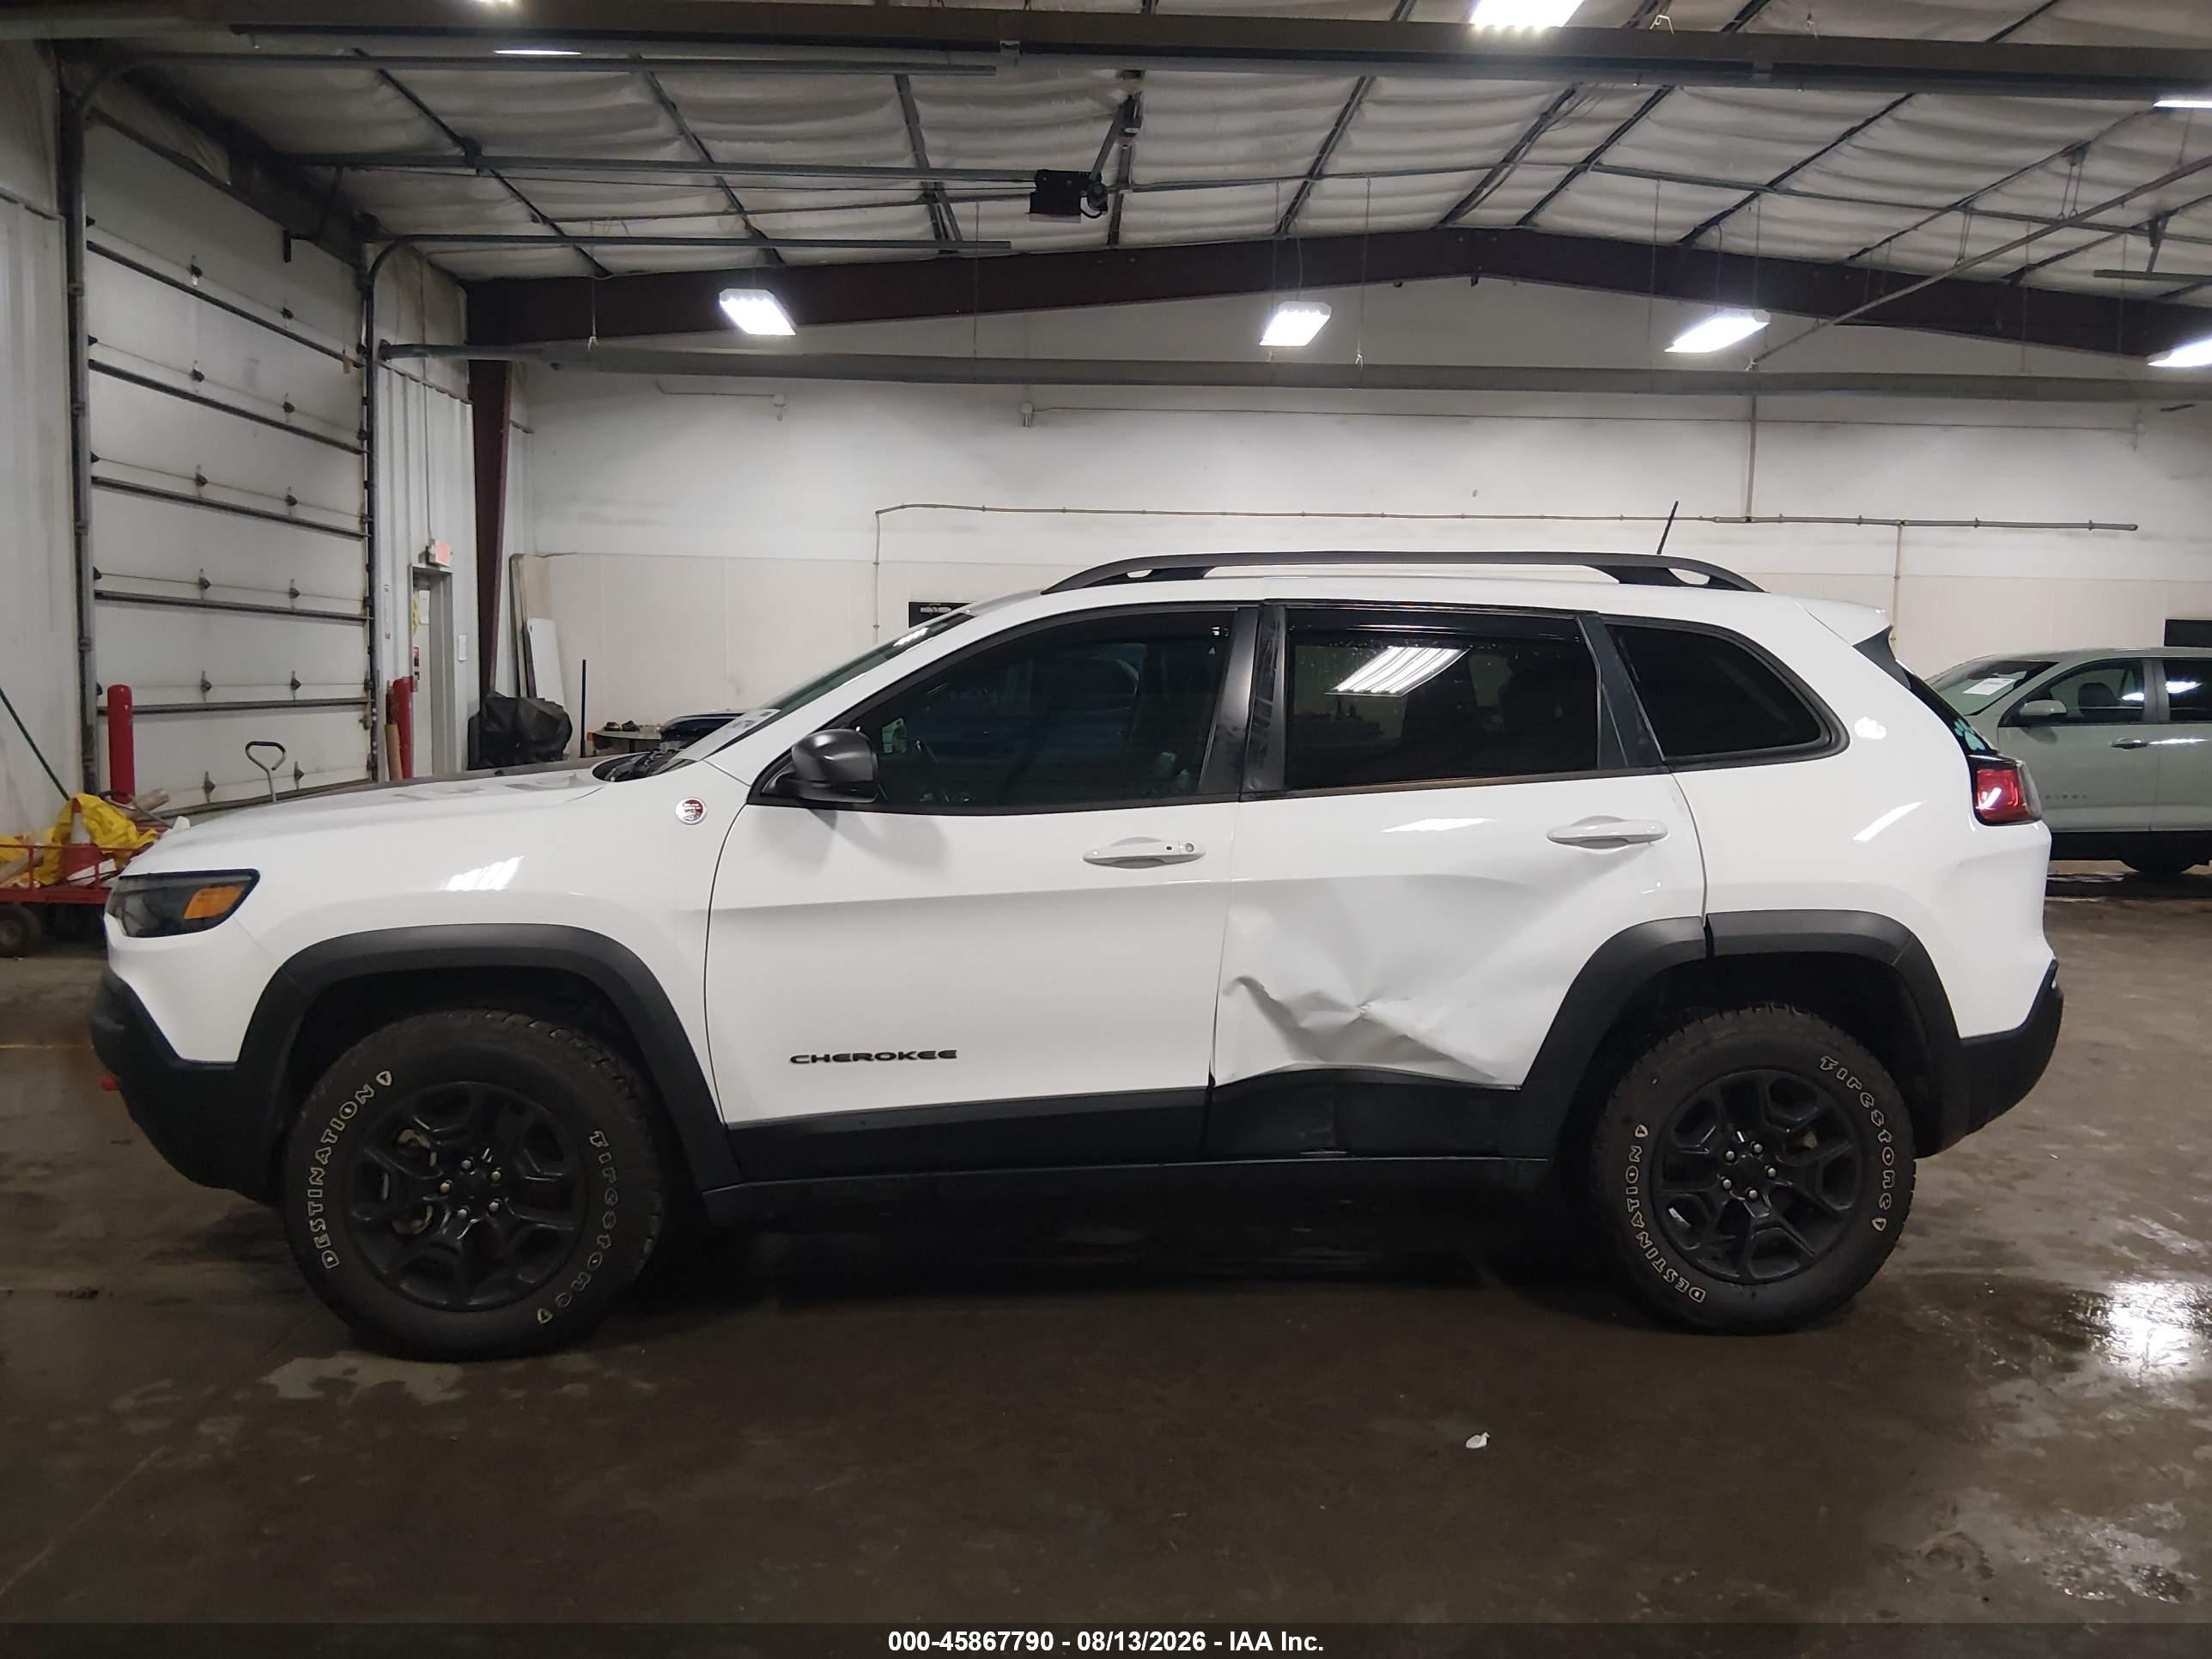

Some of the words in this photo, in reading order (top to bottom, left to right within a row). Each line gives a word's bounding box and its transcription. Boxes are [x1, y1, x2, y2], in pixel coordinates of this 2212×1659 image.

[790, 1049, 957, 1065] CHEROKEE
[307, 1084, 374, 1269] DESTINATION
[1626, 1146, 1706, 1304] DESTINATION
